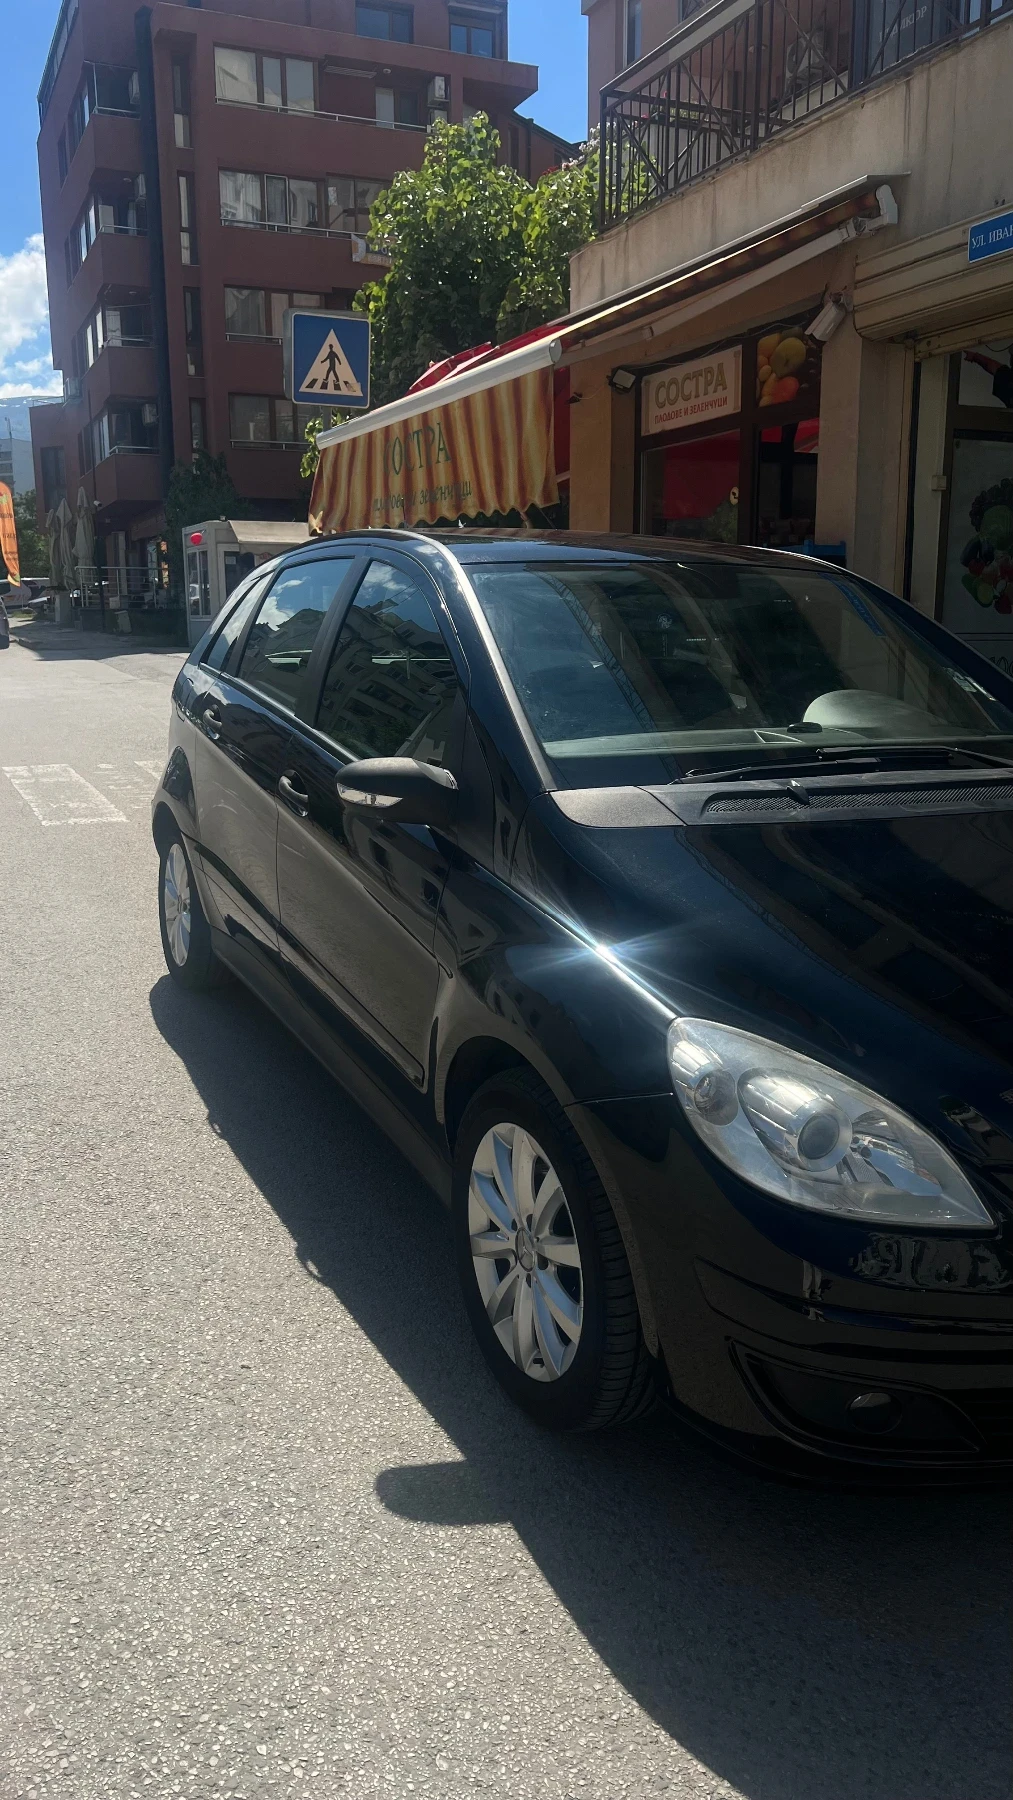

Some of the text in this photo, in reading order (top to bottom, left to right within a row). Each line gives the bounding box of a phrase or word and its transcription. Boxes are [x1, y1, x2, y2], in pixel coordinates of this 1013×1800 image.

[972, 234, 986, 249] УЛ.
[655, 362, 728, 409] СОСТРА
[654, 395, 728, 425] ПЛОДОВЕ И ЗЕЛЕНЧУЦИ
[383, 421, 452, 477] СОСТРА
